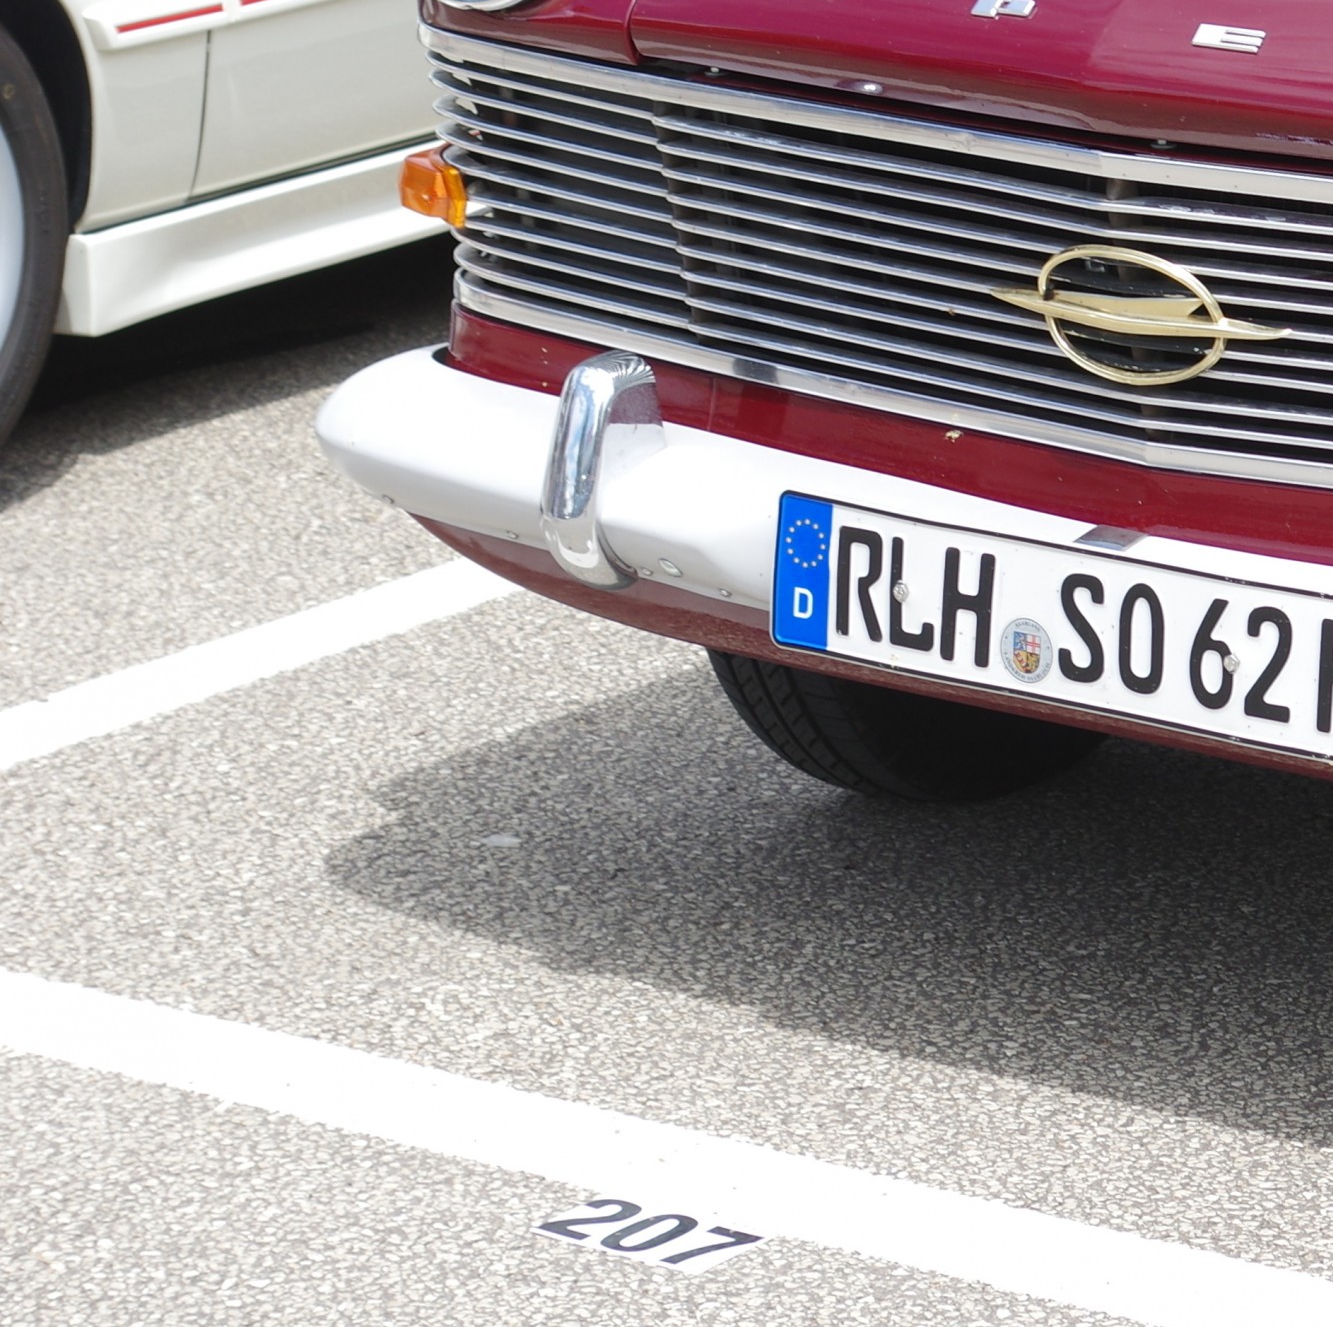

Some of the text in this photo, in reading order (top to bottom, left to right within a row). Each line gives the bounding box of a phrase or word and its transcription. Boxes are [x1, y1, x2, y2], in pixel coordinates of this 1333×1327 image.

[792, 587, 814, 620] D
[836, 525, 996, 668] RLH
[537, 1198, 765, 1265] 207
